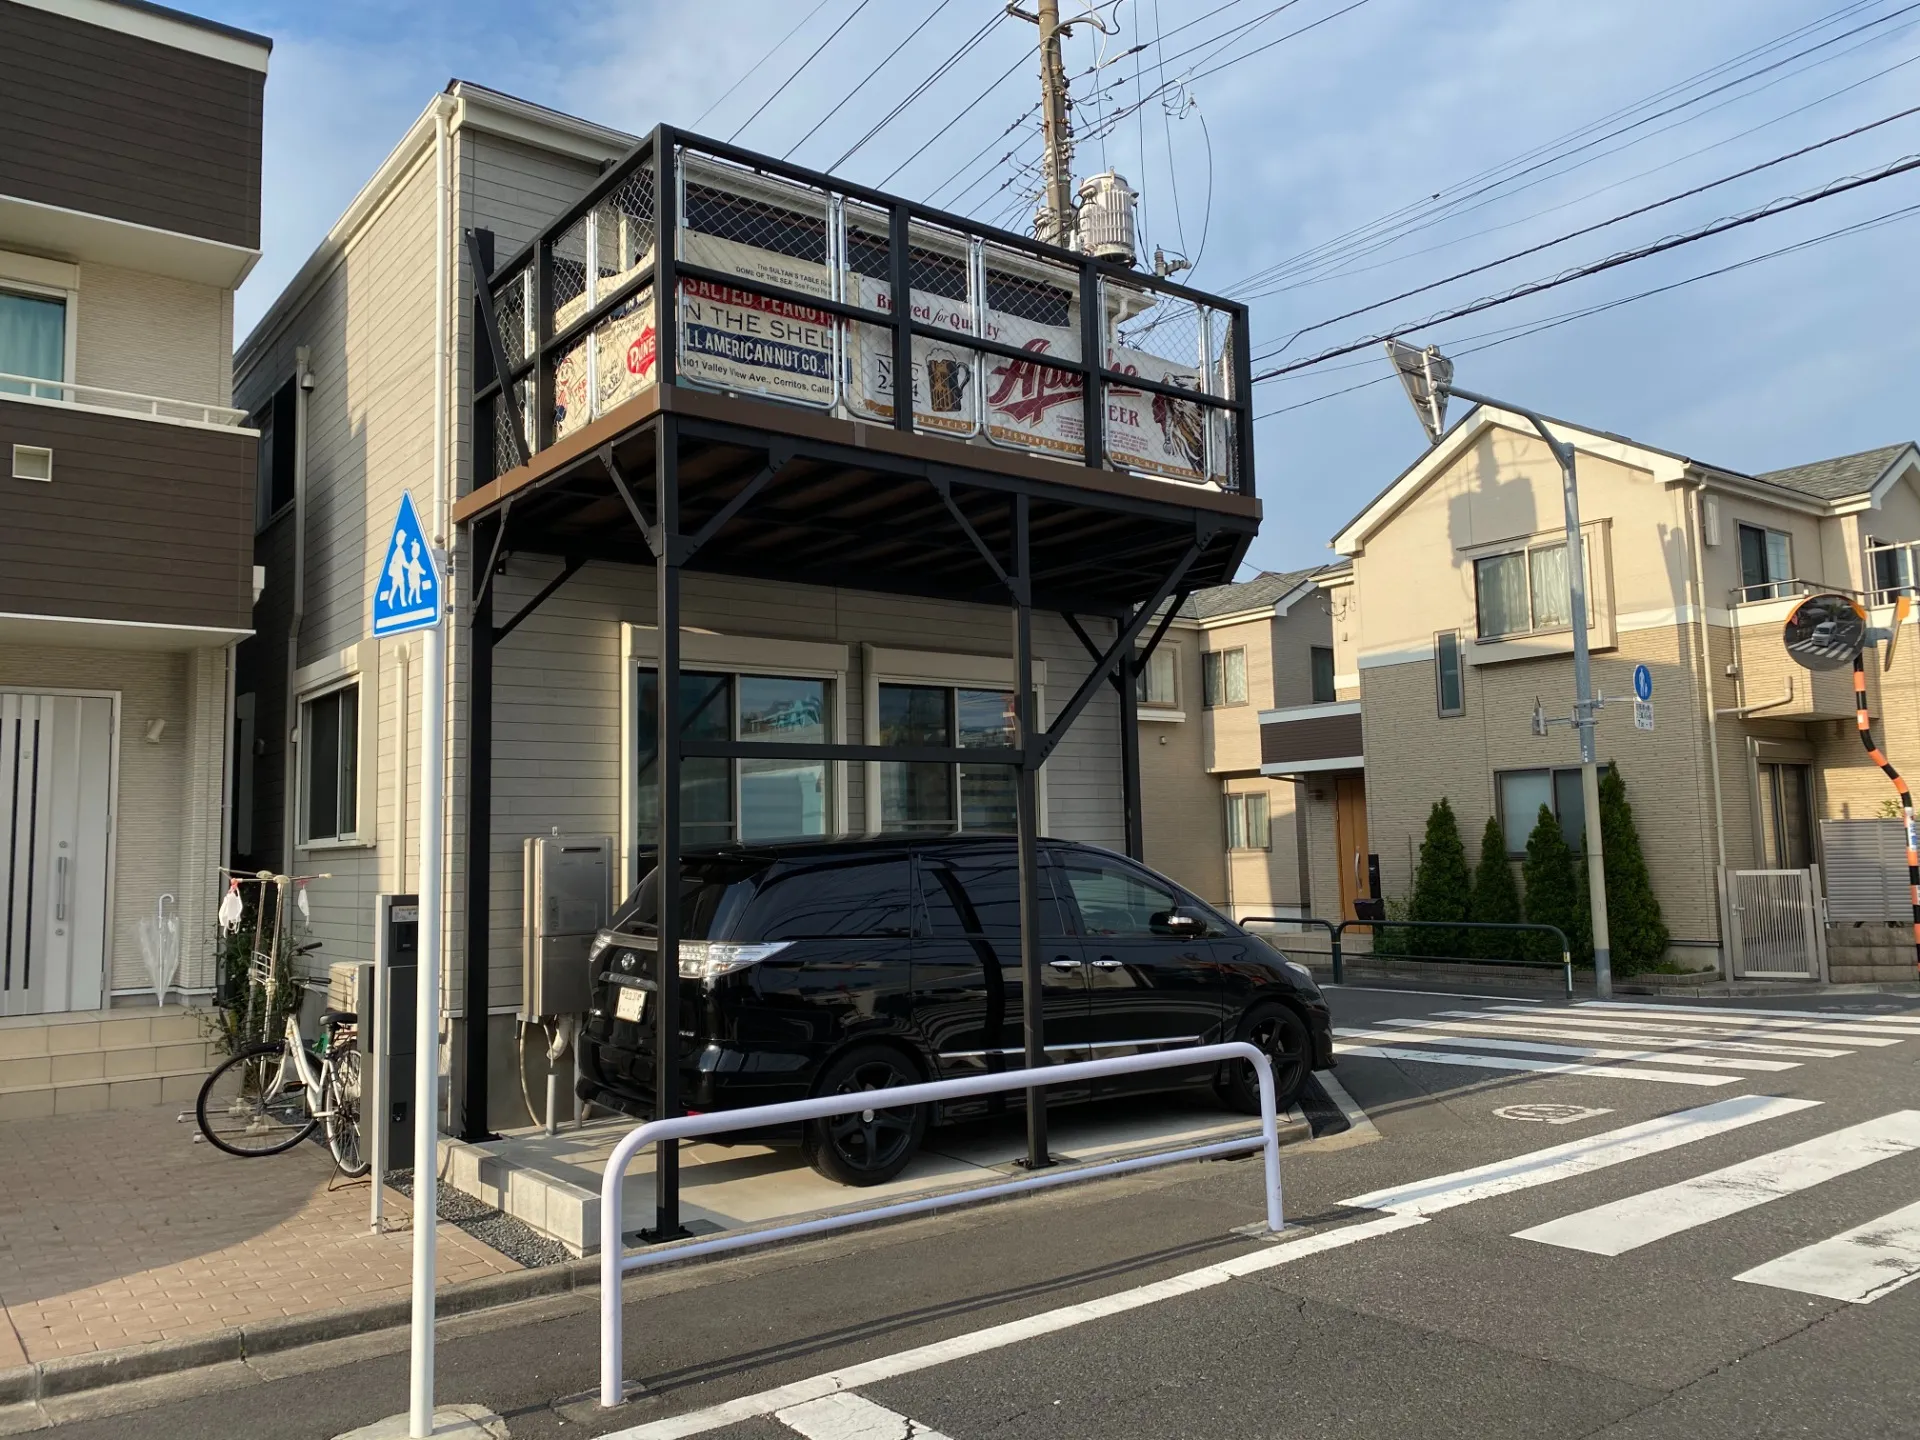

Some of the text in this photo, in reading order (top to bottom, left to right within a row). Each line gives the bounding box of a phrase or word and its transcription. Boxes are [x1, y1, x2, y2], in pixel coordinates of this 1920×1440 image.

[736, 266, 755, 277] DOME
[766, 274, 779, 283] THE
[800, 275, 820, 285] TABLE
[761, 296, 836, 327] PEANUT
[931, 309, 949, 325] for
[710, 306, 761, 334] THE
[770, 320, 842, 352] SHEL
[705, 332, 773, 364] AMERICAN
[774, 347, 800, 369] NUT
[701, 361, 728, 376] Valley
[1103, 404, 1140, 427] EER
